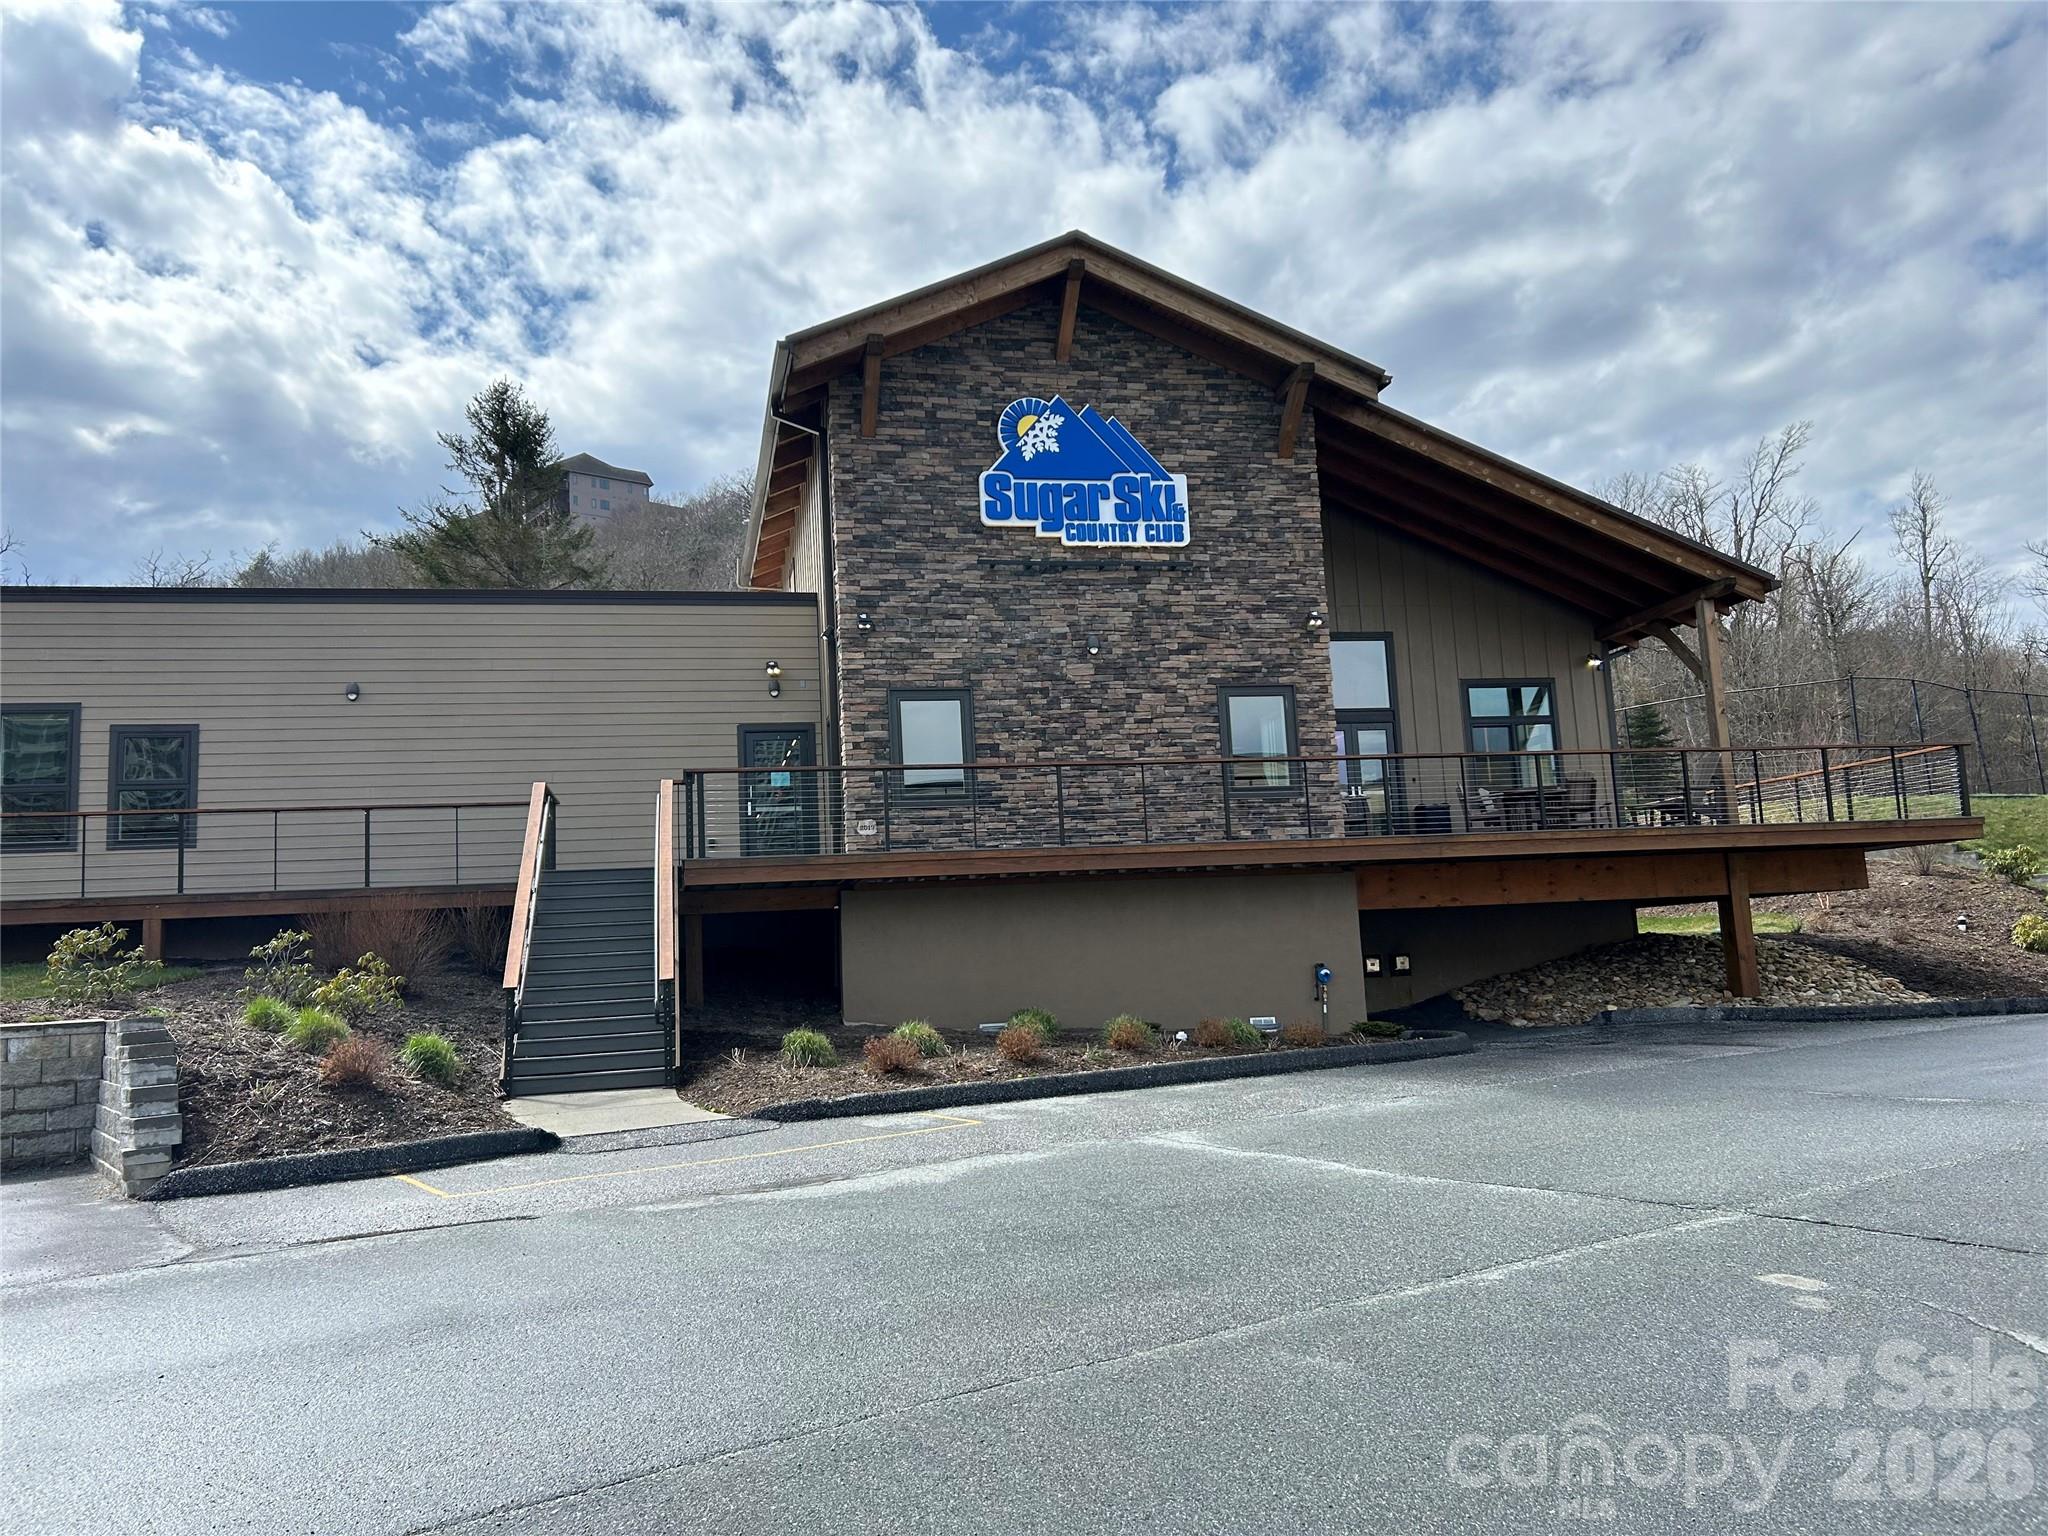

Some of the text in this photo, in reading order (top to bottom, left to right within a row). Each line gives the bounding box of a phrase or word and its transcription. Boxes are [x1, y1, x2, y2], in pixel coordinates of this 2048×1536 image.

[984, 473, 1186, 532] Sugar Ski &
[1065, 523, 1185, 542] COUNTRY CLUB
